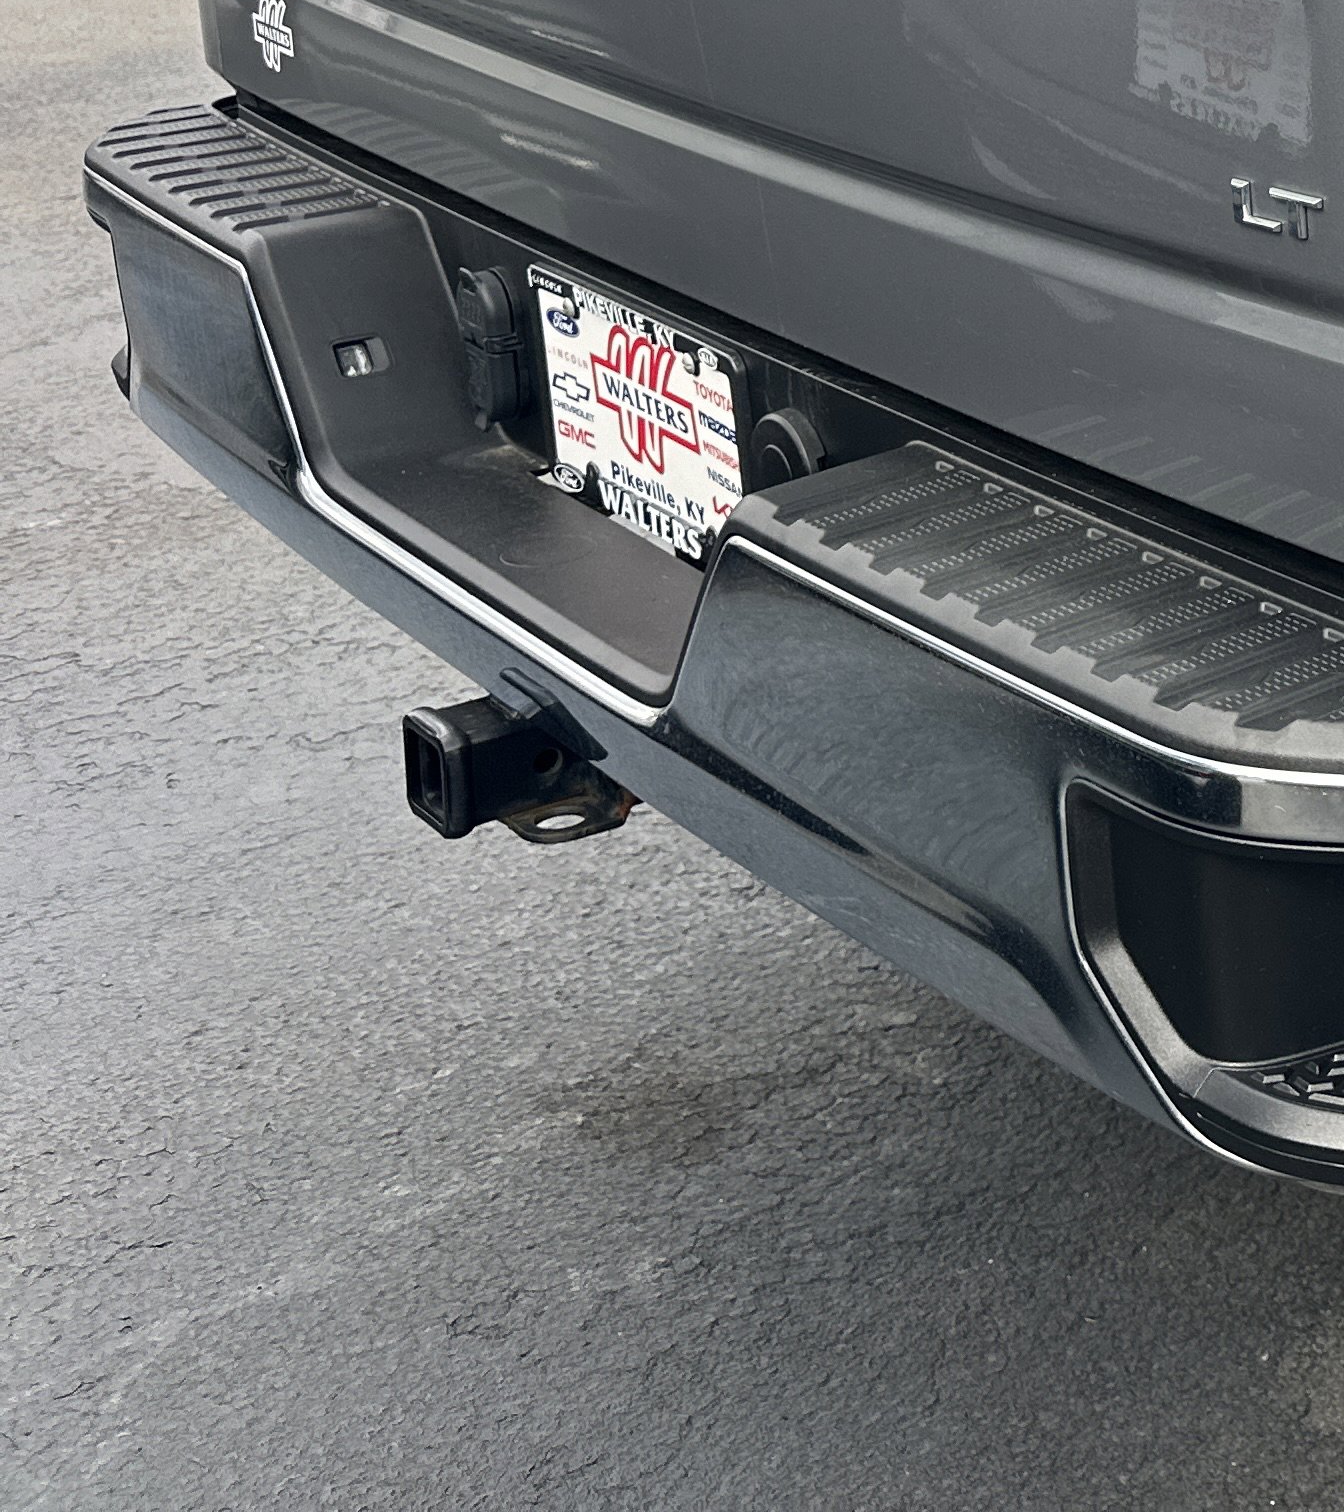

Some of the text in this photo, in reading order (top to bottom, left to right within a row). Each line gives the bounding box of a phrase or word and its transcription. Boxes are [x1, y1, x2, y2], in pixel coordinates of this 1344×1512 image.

[1230, 177, 1326, 241] LT
[551, 311, 575, 335] Ford
[653, 322, 675, 352] KY
[553, 398, 595, 423] CHEVROLET
[602, 371, 688, 436] WALTERS
[693, 379, 734, 412] TOYOTA
[558, 419, 597, 450] GMC
[610, 460, 681, 515] Pikeville,
[684, 496, 705, 525] KY
[598, 479, 702, 559] WALTERS
